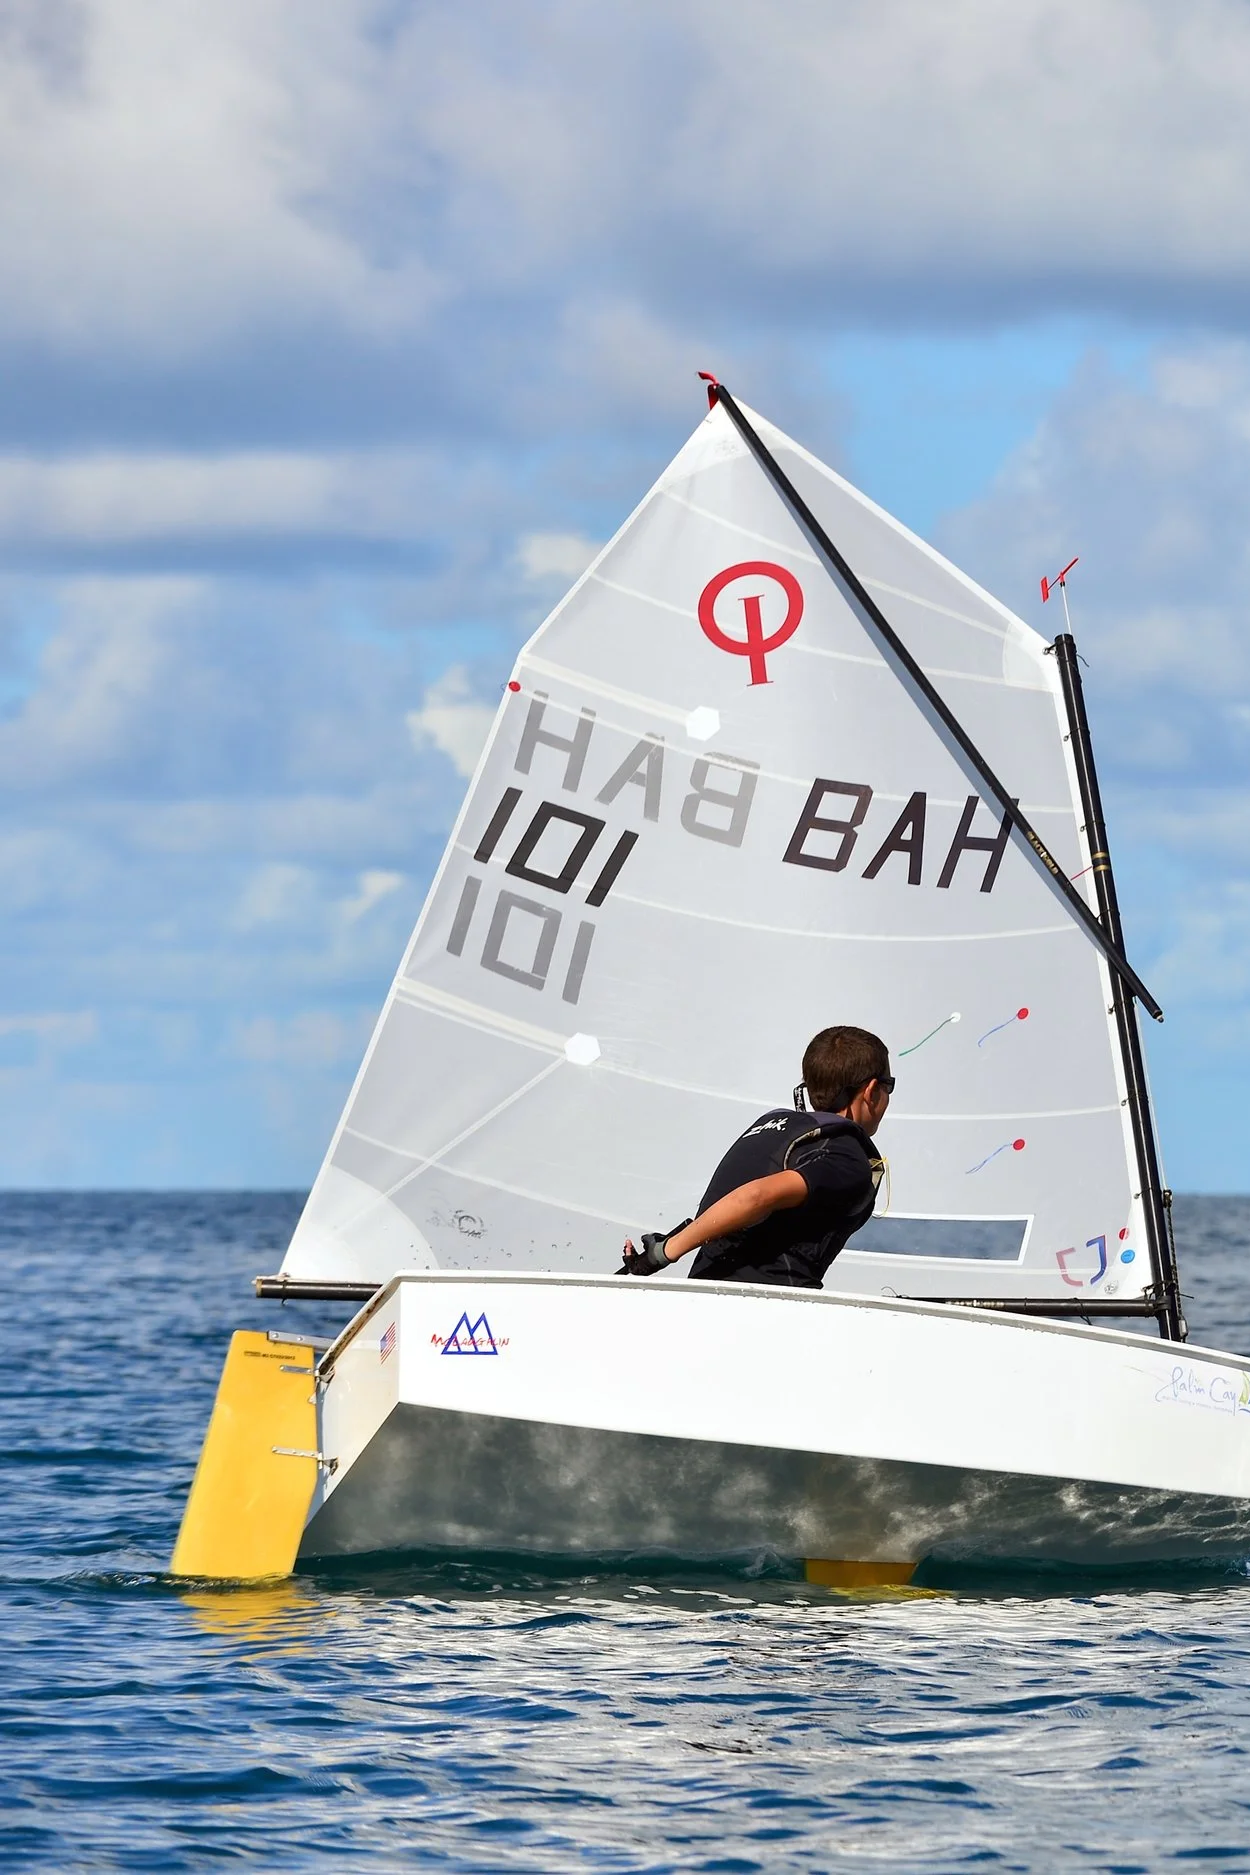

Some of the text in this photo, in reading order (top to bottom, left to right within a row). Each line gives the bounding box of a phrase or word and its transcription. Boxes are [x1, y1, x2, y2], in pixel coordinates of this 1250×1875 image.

[473, 787, 639, 907] 101
[782, 777, 1020, 893] BAH
[1209, 1377, 1237, 1416] Cay
